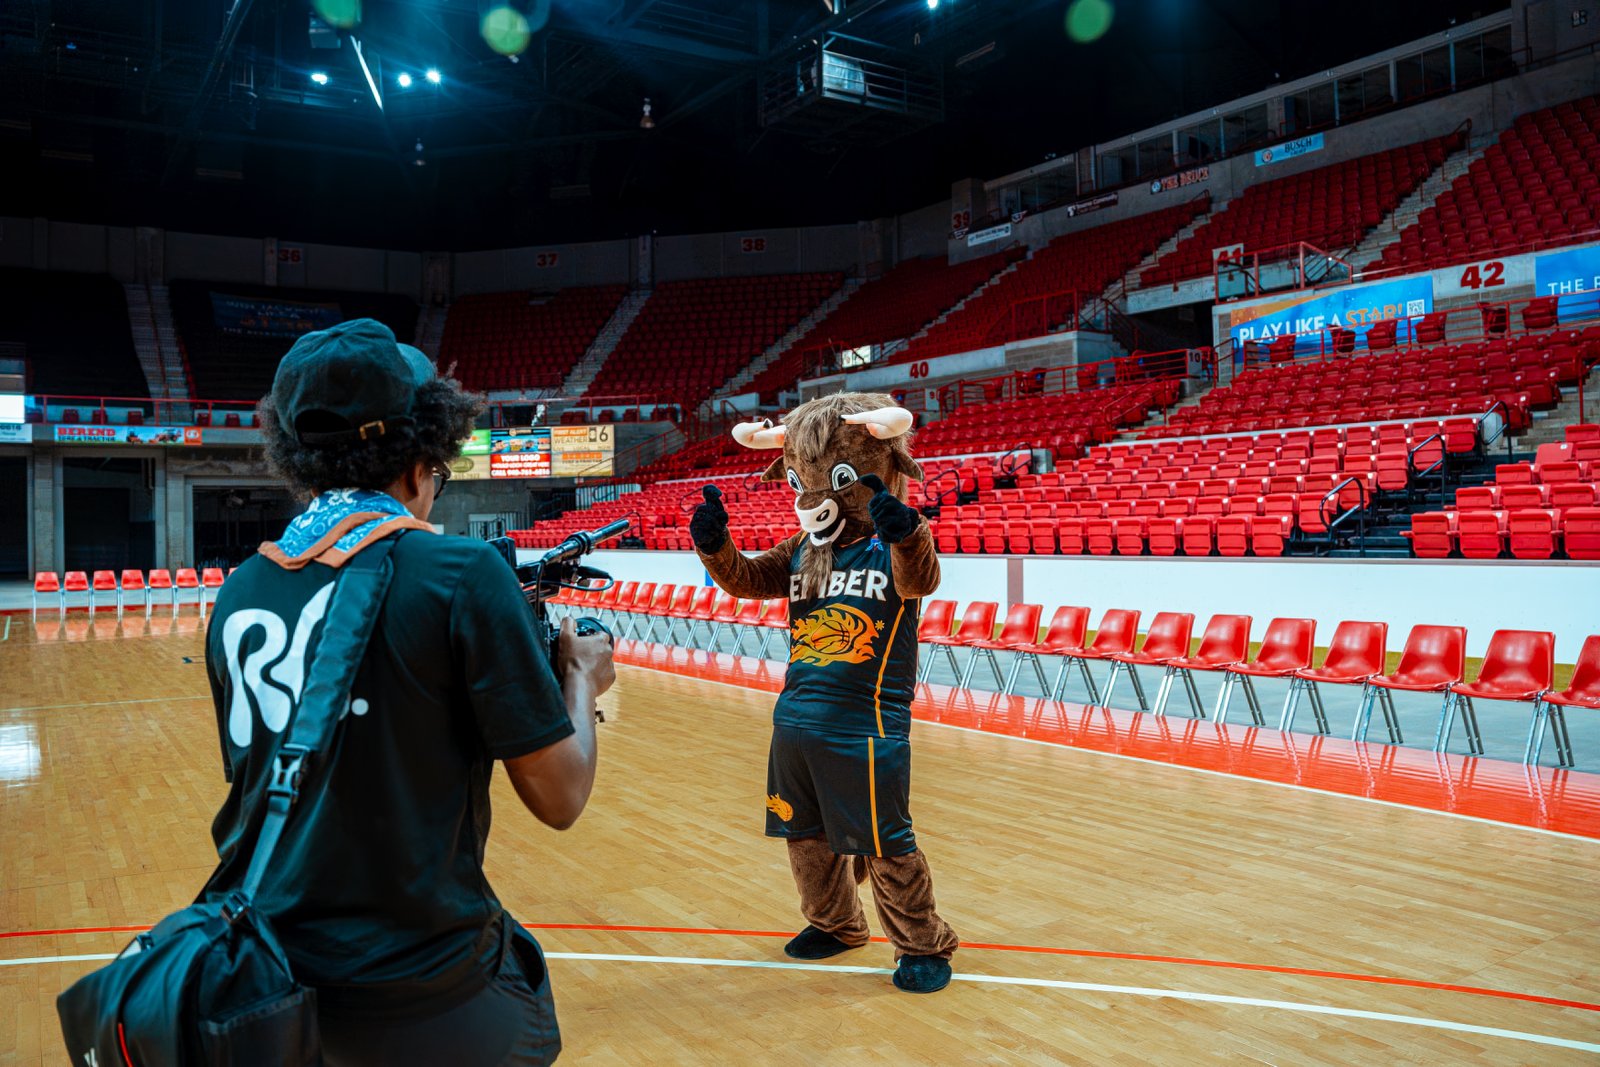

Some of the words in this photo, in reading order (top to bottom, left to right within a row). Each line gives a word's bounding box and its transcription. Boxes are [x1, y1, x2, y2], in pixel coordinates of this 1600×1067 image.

[1284, 137, 1312, 153] BUSCH
[952, 211, 970, 229] 39
[743, 238, 765, 252] 38
[279, 249, 301, 263] 36
[537, 253, 558, 267] 37
[1460, 261, 1505, 290] 42
[1548, 278, 1584, 296] THE
[1239, 321, 1283, 346] PLAY
[1285, 315, 1325, 338] LIKE
[1331, 313, 1342, 327] A
[1189, 352, 1200, 363] 10
[909, 361, 930, 379] 40
[57, 427, 116, 436] BEREND
[599, 426, 609, 442] 6
[554, 435, 588, 445] WEATHER
[500, 454, 520, 462] YOUR
[520, 453, 541, 462] LOGO
[491, 469, 507, 477] CALL
